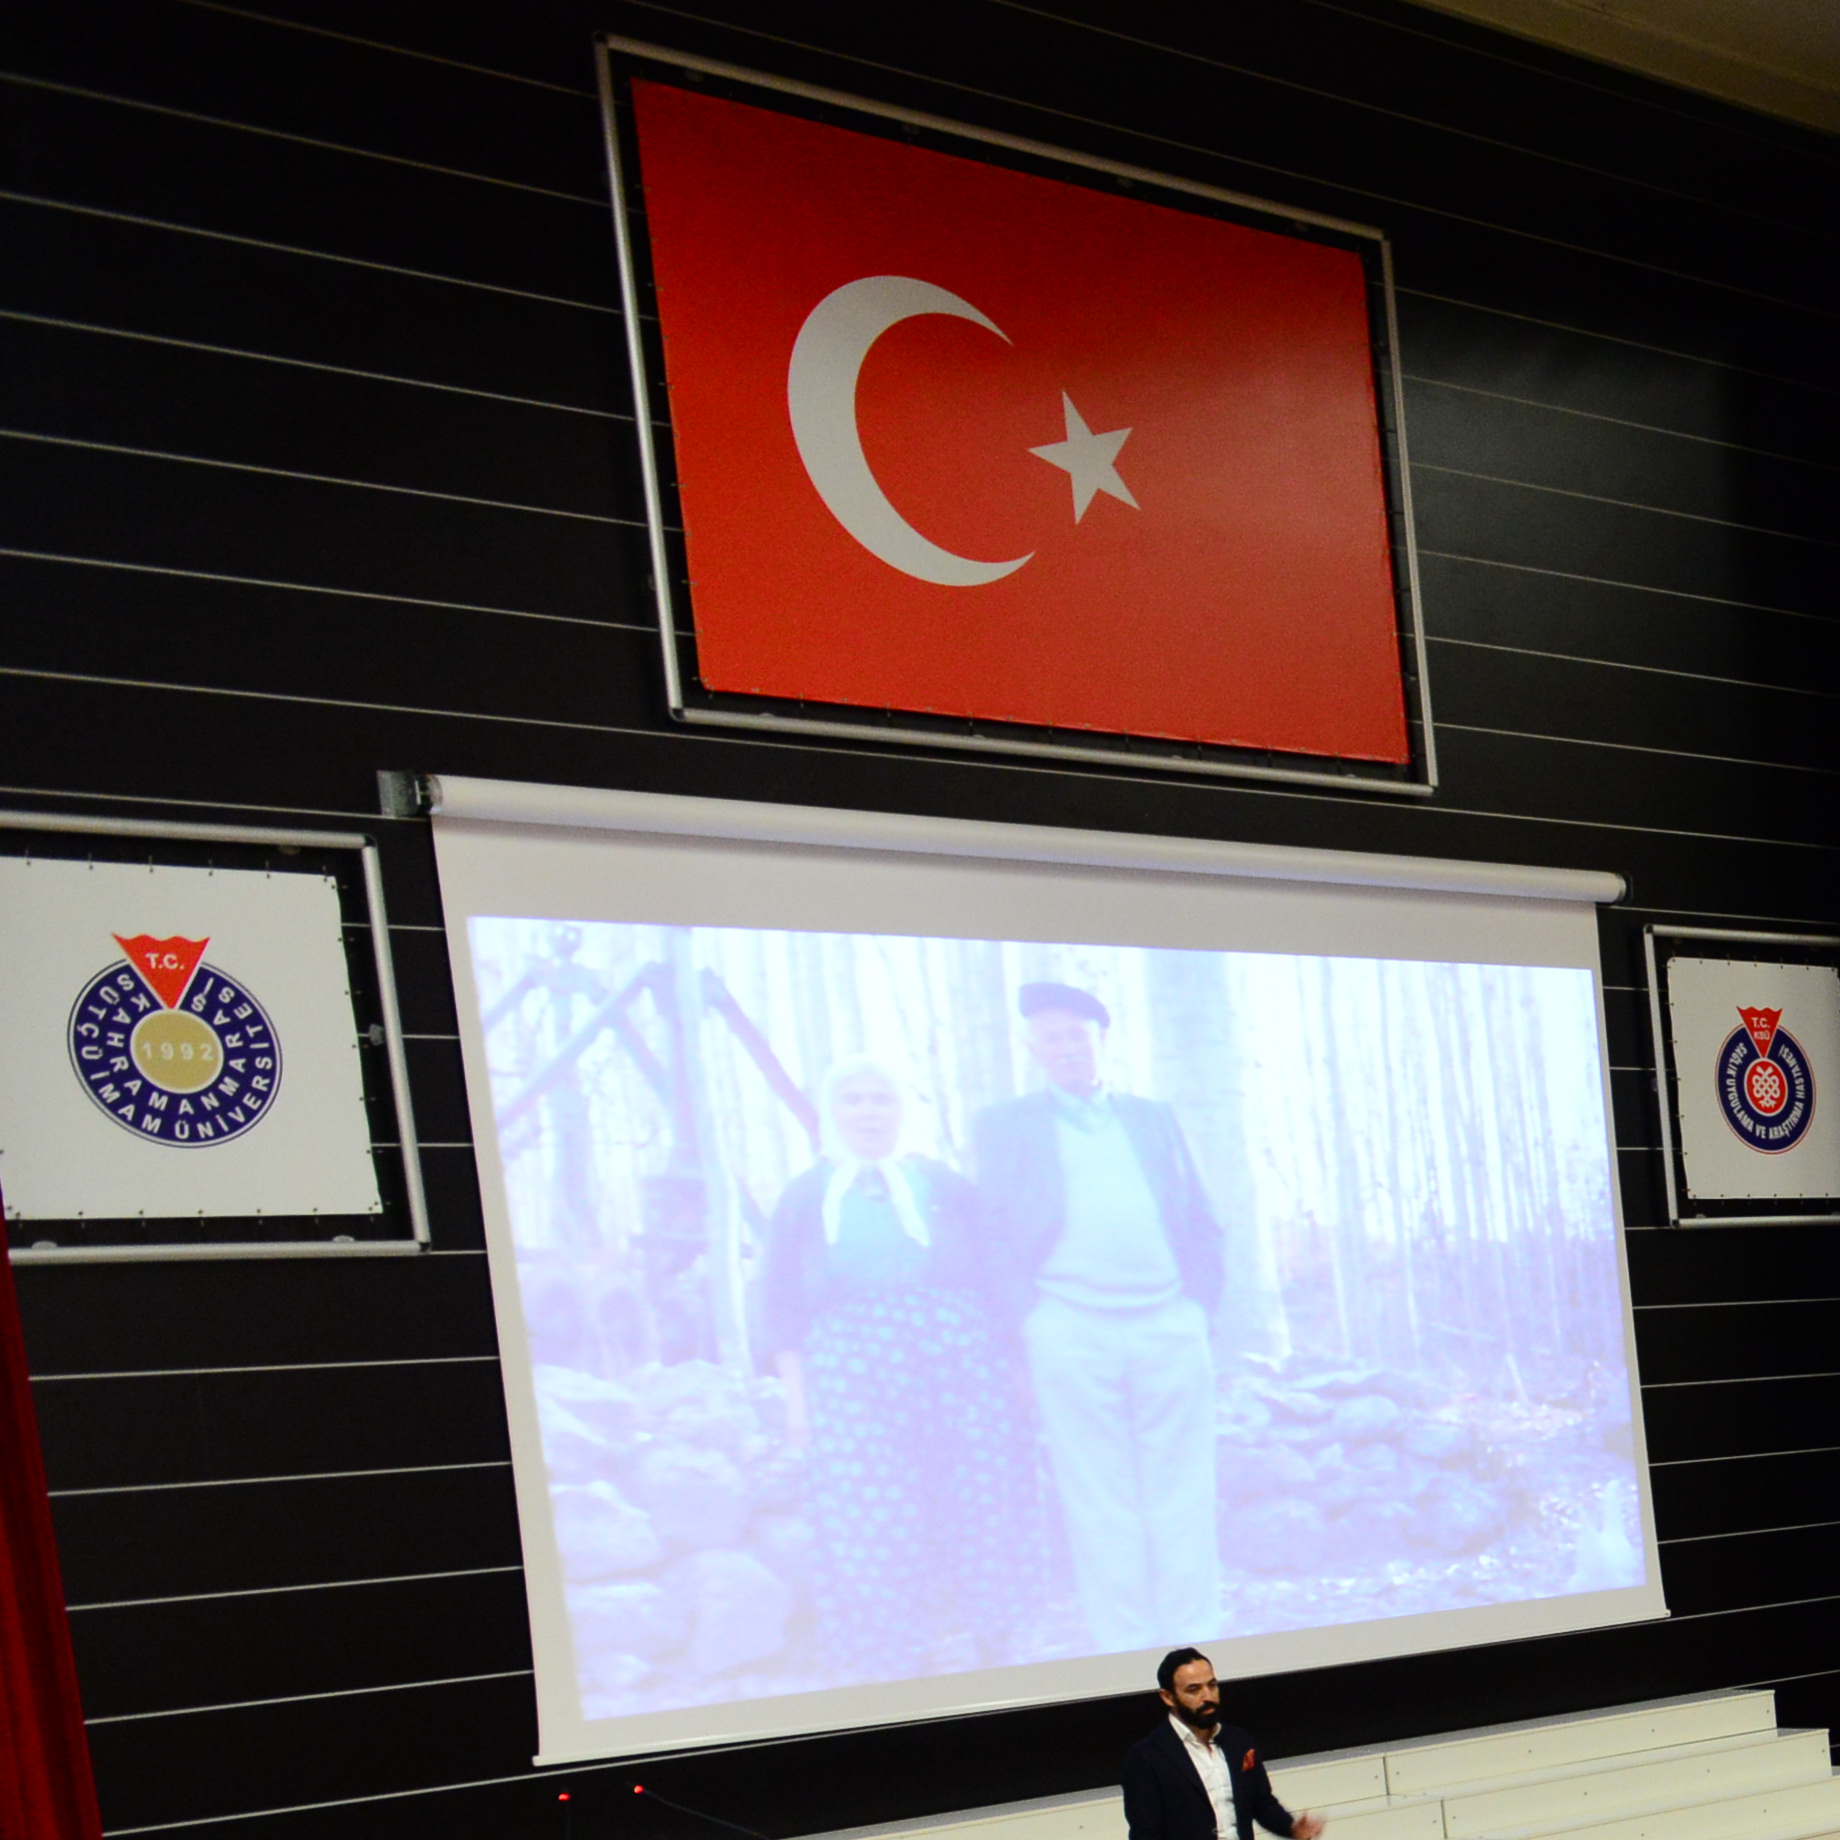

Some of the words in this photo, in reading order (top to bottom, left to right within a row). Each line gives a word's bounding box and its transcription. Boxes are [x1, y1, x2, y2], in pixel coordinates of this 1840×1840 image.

[145, 953, 184, 969] T.C.
[143, 1042, 214, 1060] 1992
[1755, 1124, 1766, 1139] VE
